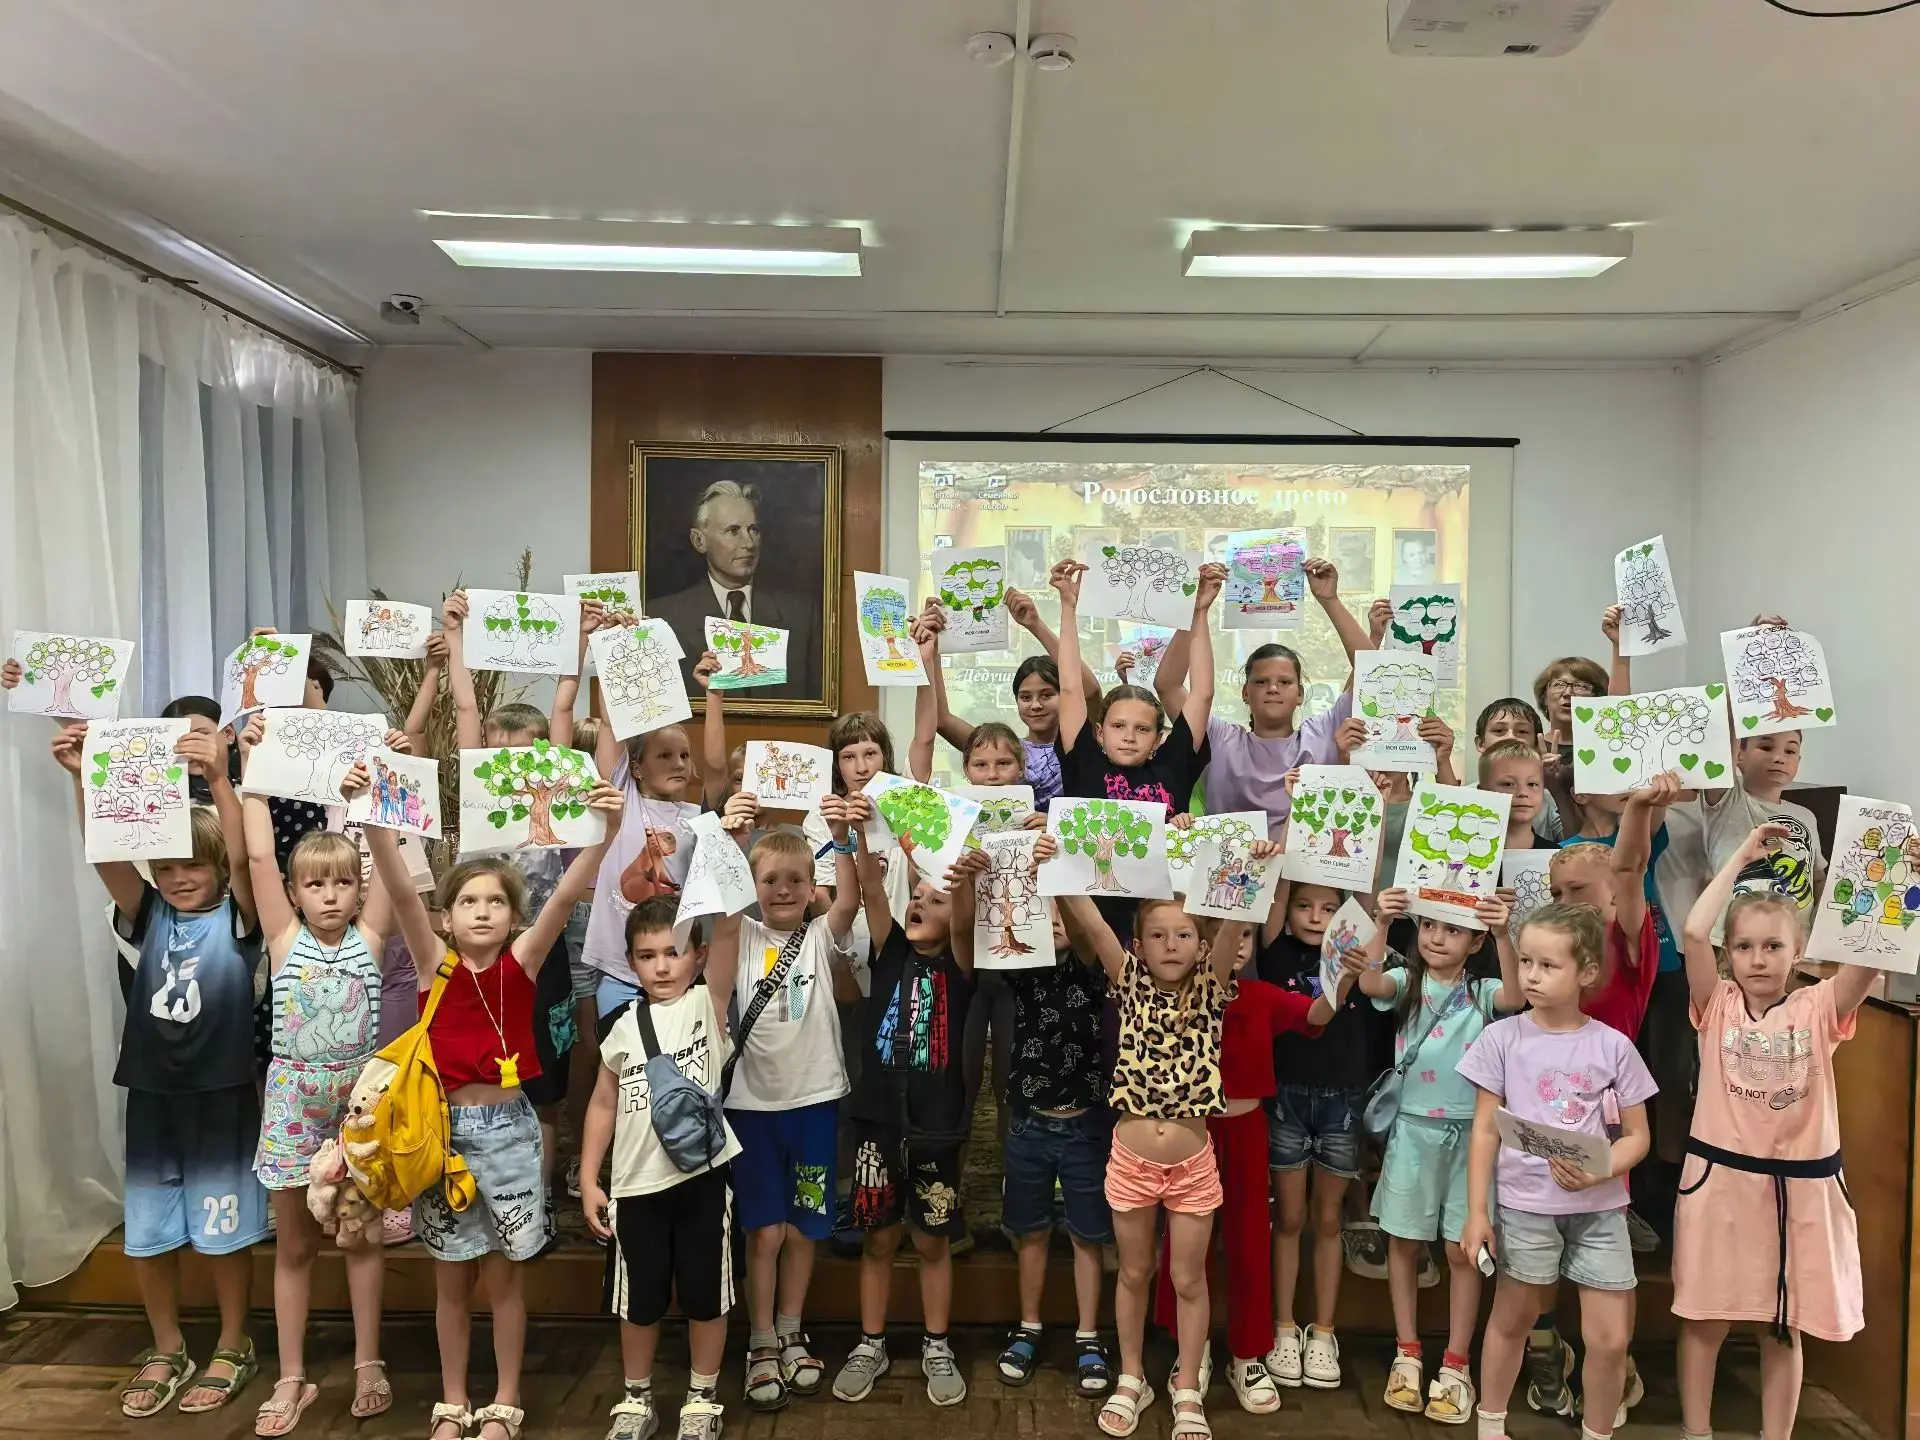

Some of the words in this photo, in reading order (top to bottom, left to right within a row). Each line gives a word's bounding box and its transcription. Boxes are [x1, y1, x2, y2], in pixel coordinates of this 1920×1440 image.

[1082, 480, 1259, 508] Родословное
[1272, 487, 1349, 512] древо
[1729, 1084, 1743, 1095] DO
[1745, 1088, 1768, 1100] NOT
[203, 1194, 240, 1236] 23
[1246, 1364, 1264, 1377] NIKE
